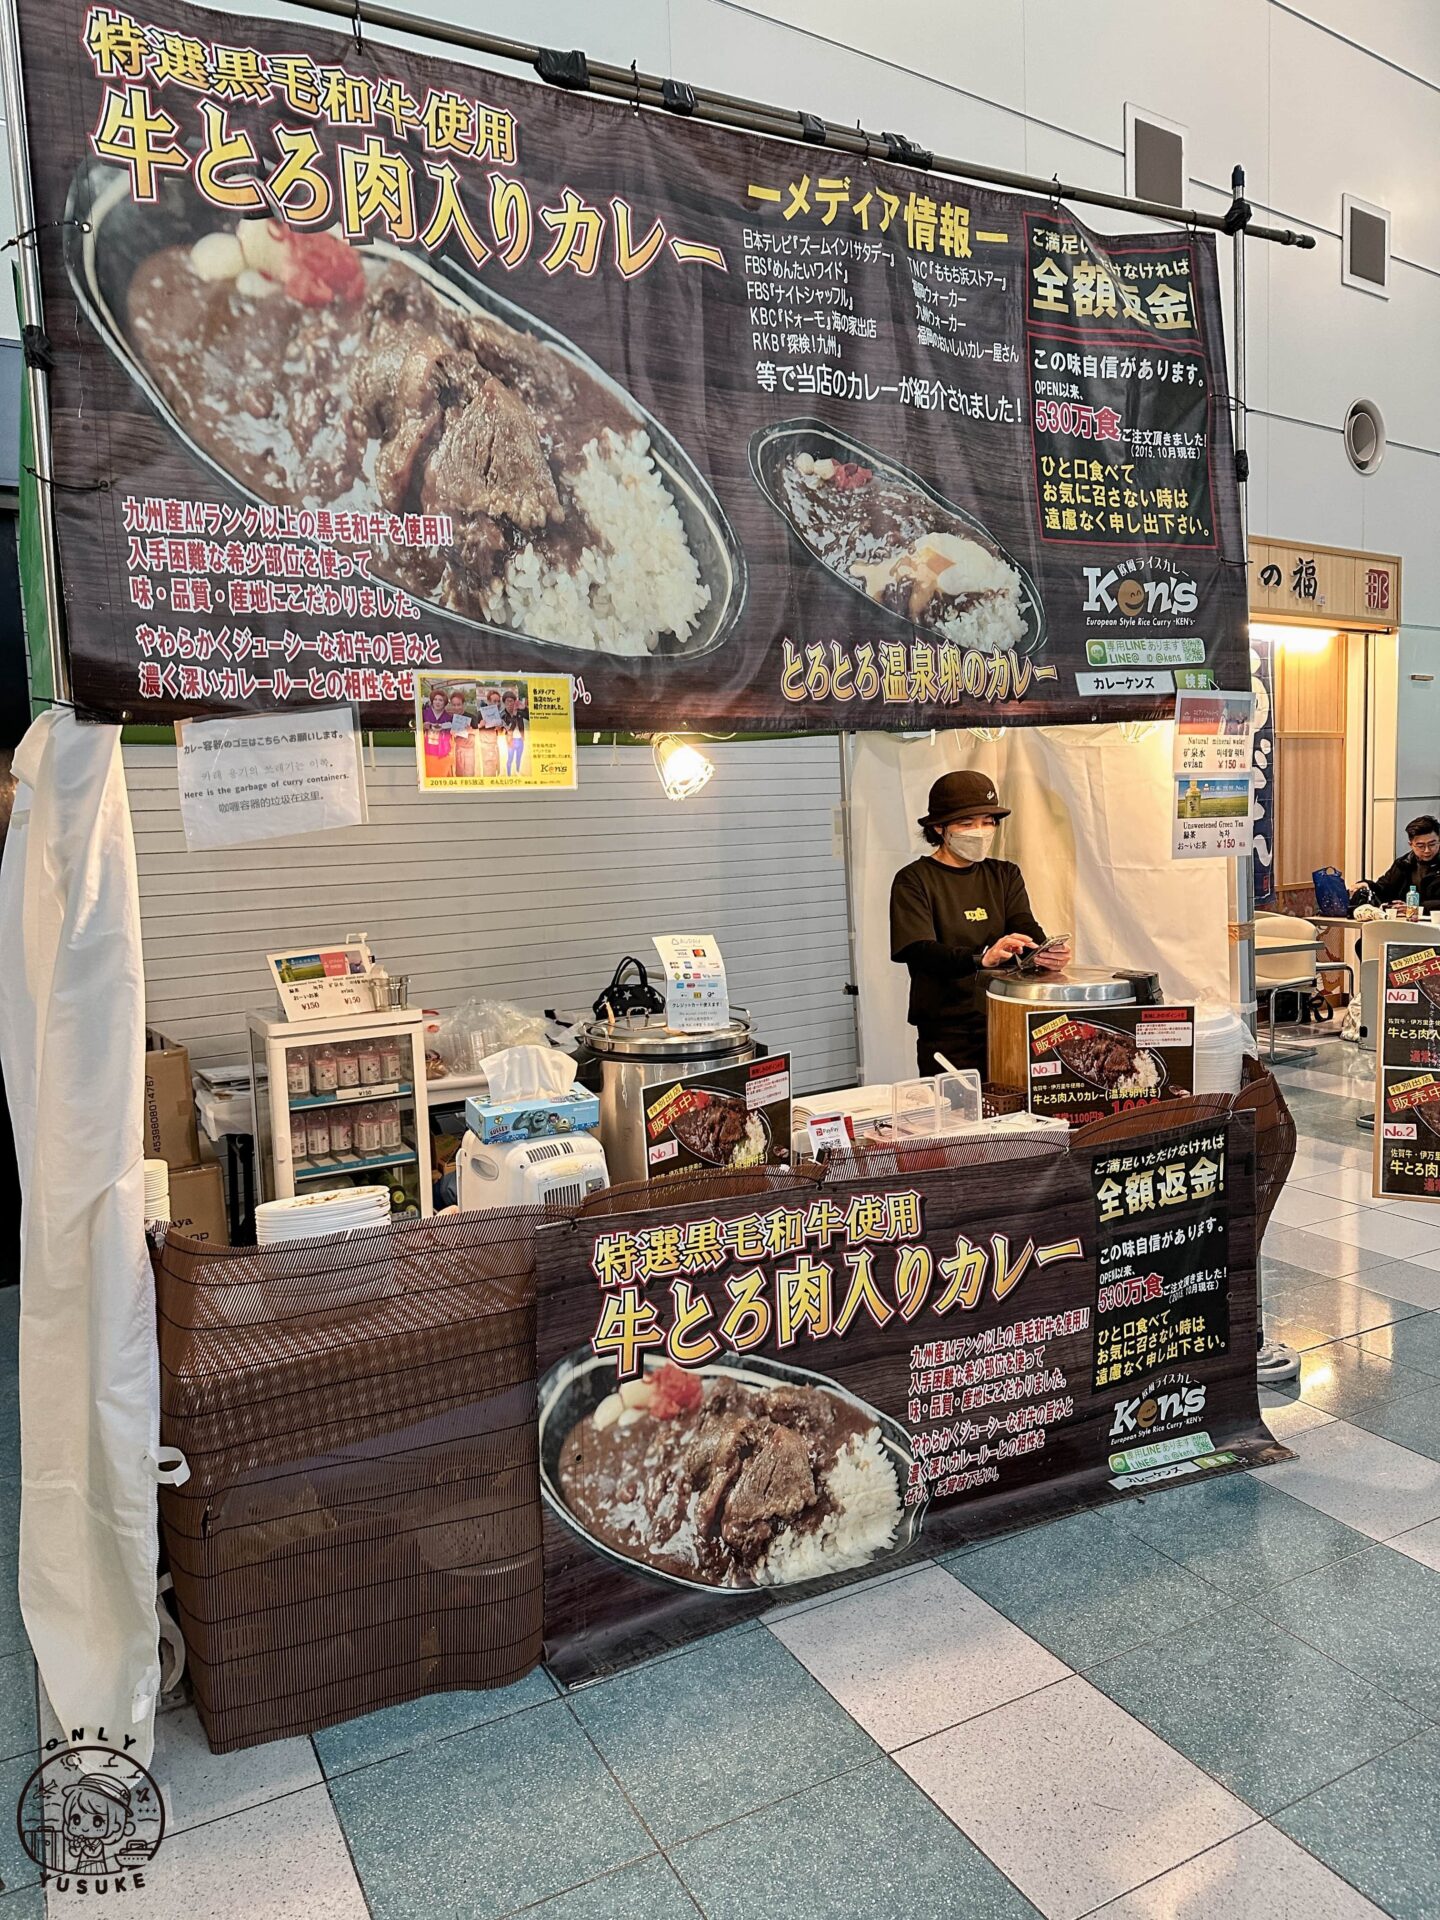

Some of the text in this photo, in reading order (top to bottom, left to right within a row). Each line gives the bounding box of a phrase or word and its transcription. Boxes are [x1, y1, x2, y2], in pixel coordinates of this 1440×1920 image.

[84, 8, 519, 166] 特選黒毛和牛使用
[91, 84, 728, 280] 牛とろ肉入りカレー
[744, 256, 849, 283] FBS『めんたいワイド』
[746, 281, 853, 310] FBS『ナイトシャッフル』
[1034, 350, 1204, 387] この味自信があります。
[1034, 381, 1084, 400] OPEN以来、
[1035, 400, 1122, 442] 530万食
[1041, 455, 1135, 484] ひと口食べて
[1042, 483, 1189, 510] お気に召さない時は
[1045, 507, 1210, 537] 遠慮なく申し出下さい。
[127, 537, 373, 580] 入手困難な希少部位を使って
[1117, 555, 1190, 577] 欧風ライスカレー
[128, 576, 421, 620] 味・品質・産地にこだわりました。
[1086, 617, 1117, 628] European
[1119, 617, 1136, 628] Style
[1137, 617, 1151, 626] Rice
[1152, 617, 1172, 628] Curry
[136, 624, 443, 664] やわらかくジューシーな和牛の旨みと
[1109, 653, 1140, 664] LINE@
[781, 637, 1058, 702] とろとろ温泉卵のカレー
[1183, 758, 1203, 768] evian
[184, 773, 350, 799] Here is the garbage of curry containers.
[1219, 820, 1233, 828] Green
[301, 1002, 320, 1010] ¥150
[1034, 1015, 1067, 1037] 特別出店
[1035, 1024, 1078, 1053] 販売中
[1033, 1087, 1160, 1105] 牛とろ肉入りカレー(温泉卵付き)
[1390, 1075, 1432, 1093] 特別出店
[650, 1095, 693, 1136] 販売中
[823, 1126, 840, 1134] PayPay
[1384, 1125, 1415, 1137] No.2
[1094, 1133, 1225, 1176] ご満足いただけなければ
[1096, 1152, 1225, 1223] 全額返金!
[594, 1190, 922, 1287] 特選黒毛和牛使用
[1100, 1215, 1224, 1266] この味自信があります。
[591, 1234, 1085, 1380] 牛とろ肉入りカレー
[1098, 1272, 1164, 1313] 530万食
[1097, 1316, 1206, 1366] お気に召さない時は
[1098, 1310, 1171, 1346] ひと口食べて
[908, 1345, 1046, 1397] 入手困難な希少部位を使って
[1095, 1334, 1227, 1387] 遠慮なく申し出下さい。
[908, 1368, 1067, 1423] 味・品質・産地にこだわりました。
[910, 1396, 1074, 1459] やわらかくジューシーな和牛の旨みと
[1111, 1434, 1137, 1446] European
[1138, 1428, 1151, 1439] Style
[1152, 1425, 1165, 1433] Rice
[1166, 1422, 1183, 1431] Curry
[907, 1429, 1046, 1486] 濃く深いカレールーとの相性を
